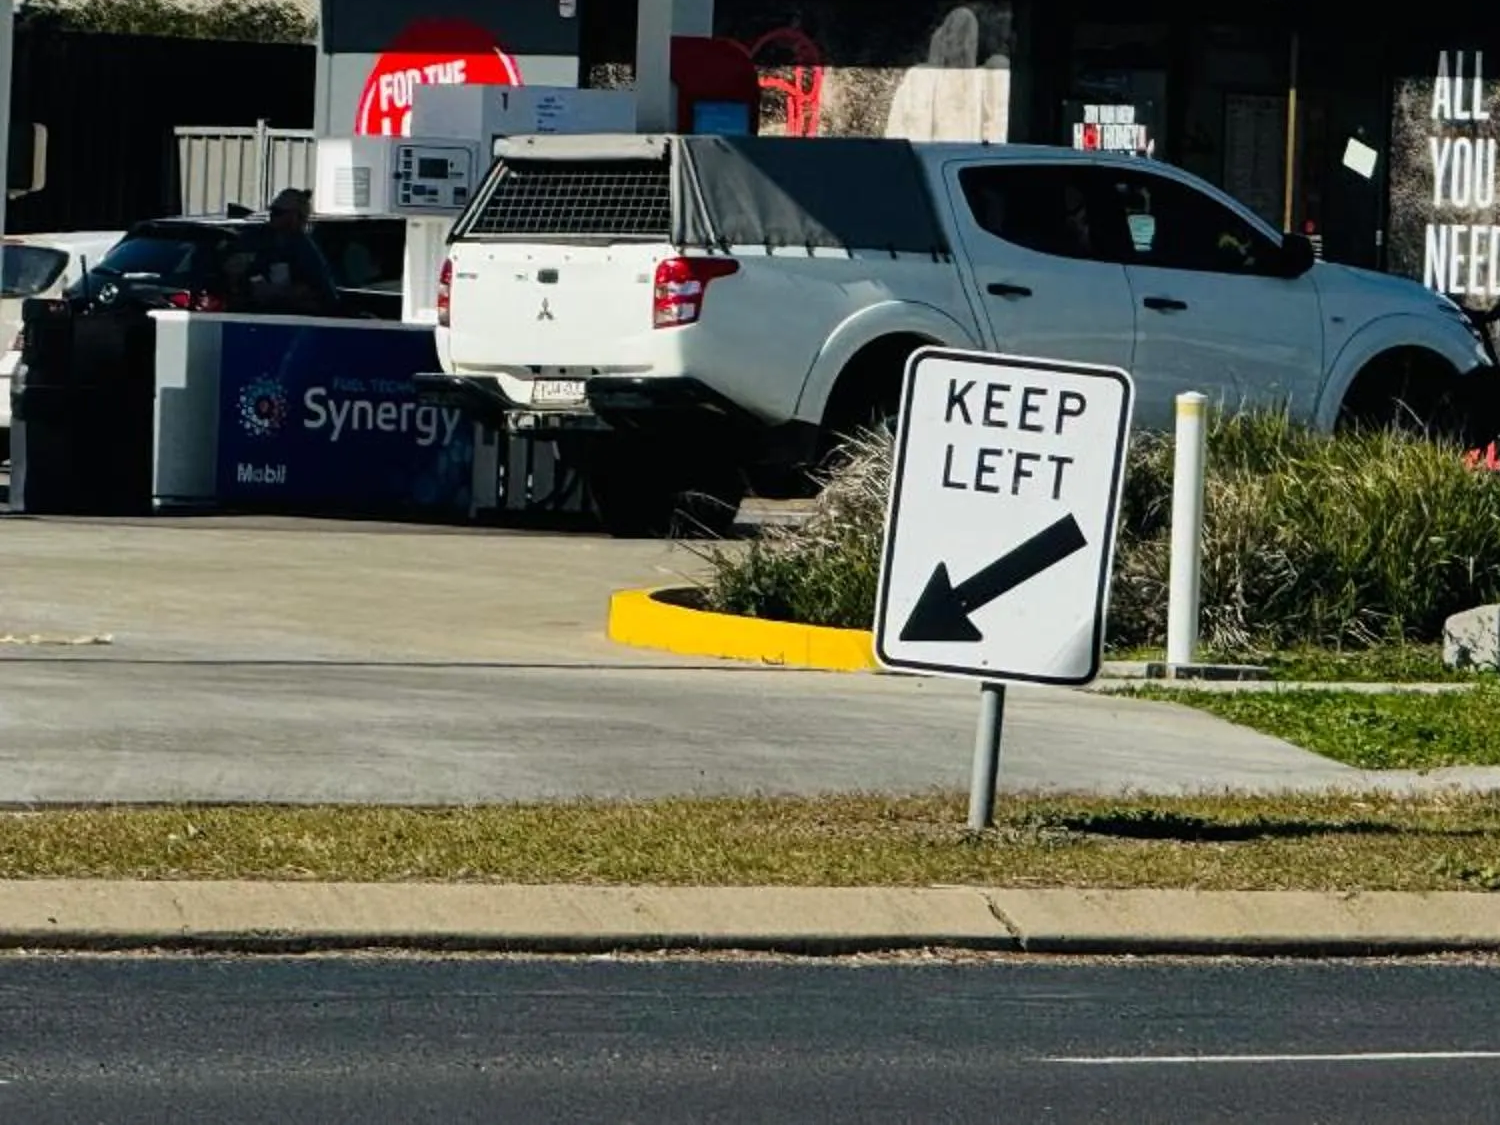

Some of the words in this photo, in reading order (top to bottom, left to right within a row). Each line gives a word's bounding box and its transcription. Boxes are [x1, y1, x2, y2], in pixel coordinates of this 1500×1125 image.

[1431, 50, 1490, 120] ALL
[1428, 136, 1496, 209] YOU
[304, 386, 460, 446] Synergy
[945, 378, 1088, 436] KEEP
[237, 462, 286, 484] Mobil
[942, 444, 1074, 500] LEFT
